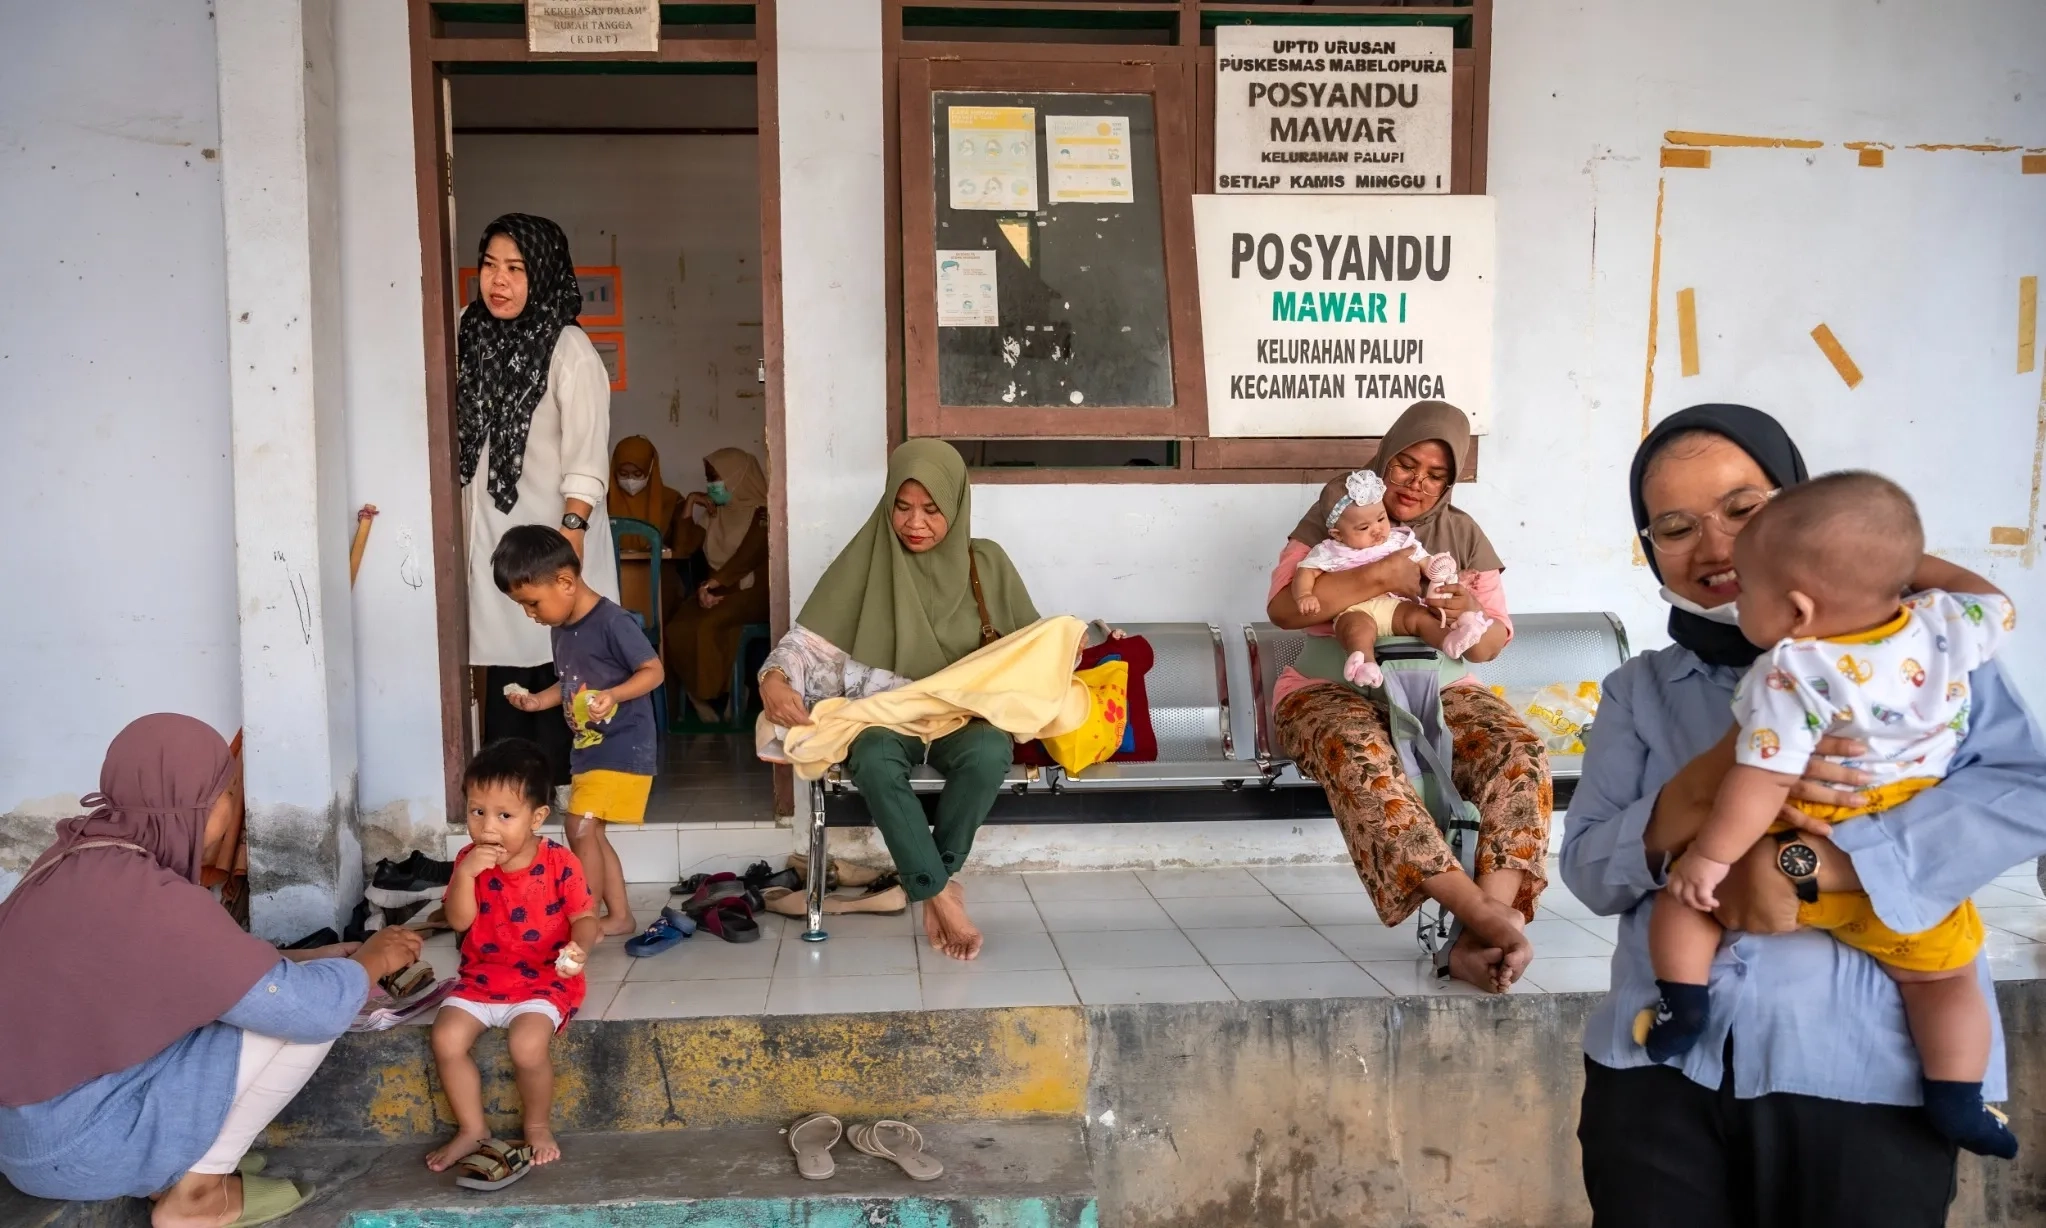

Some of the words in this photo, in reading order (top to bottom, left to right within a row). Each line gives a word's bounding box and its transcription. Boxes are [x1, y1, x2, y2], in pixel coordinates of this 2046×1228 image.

[553, 21, 588, 30] RUMAH
[592, 21, 633, 30] TANGGA
[1272, 39, 1319, 55] UPTD
[1324, 39, 1396, 55] URUSAN
[1219, 58, 1326, 73] PUSKESMAS
[1329, 58, 1447, 74] MABELOPURA
[1248, 81, 1419, 109] POSYANDU
[1269, 116, 1397, 143] MAWAR
[1261, 151, 1349, 164] KELURAHAN
[1353, 151, 1405, 164] PALUPI
[1218, 174, 1281, 189] SETIAP
[1290, 174, 1345, 189] KAMIS
[1355, 174, 1426, 190] MINGGU
[1231, 232, 1452, 282] POSYANDU
[1272, 291, 1387, 323] MAWAR
[1399, 292, 1407, 323] I
[1257, 338, 1356, 364] KELURAHAN
[1360, 338, 1423, 364] PALUPI
[1230, 374, 1345, 400] KECAMATAN
[1354, 374, 1446, 400] TATANGA
